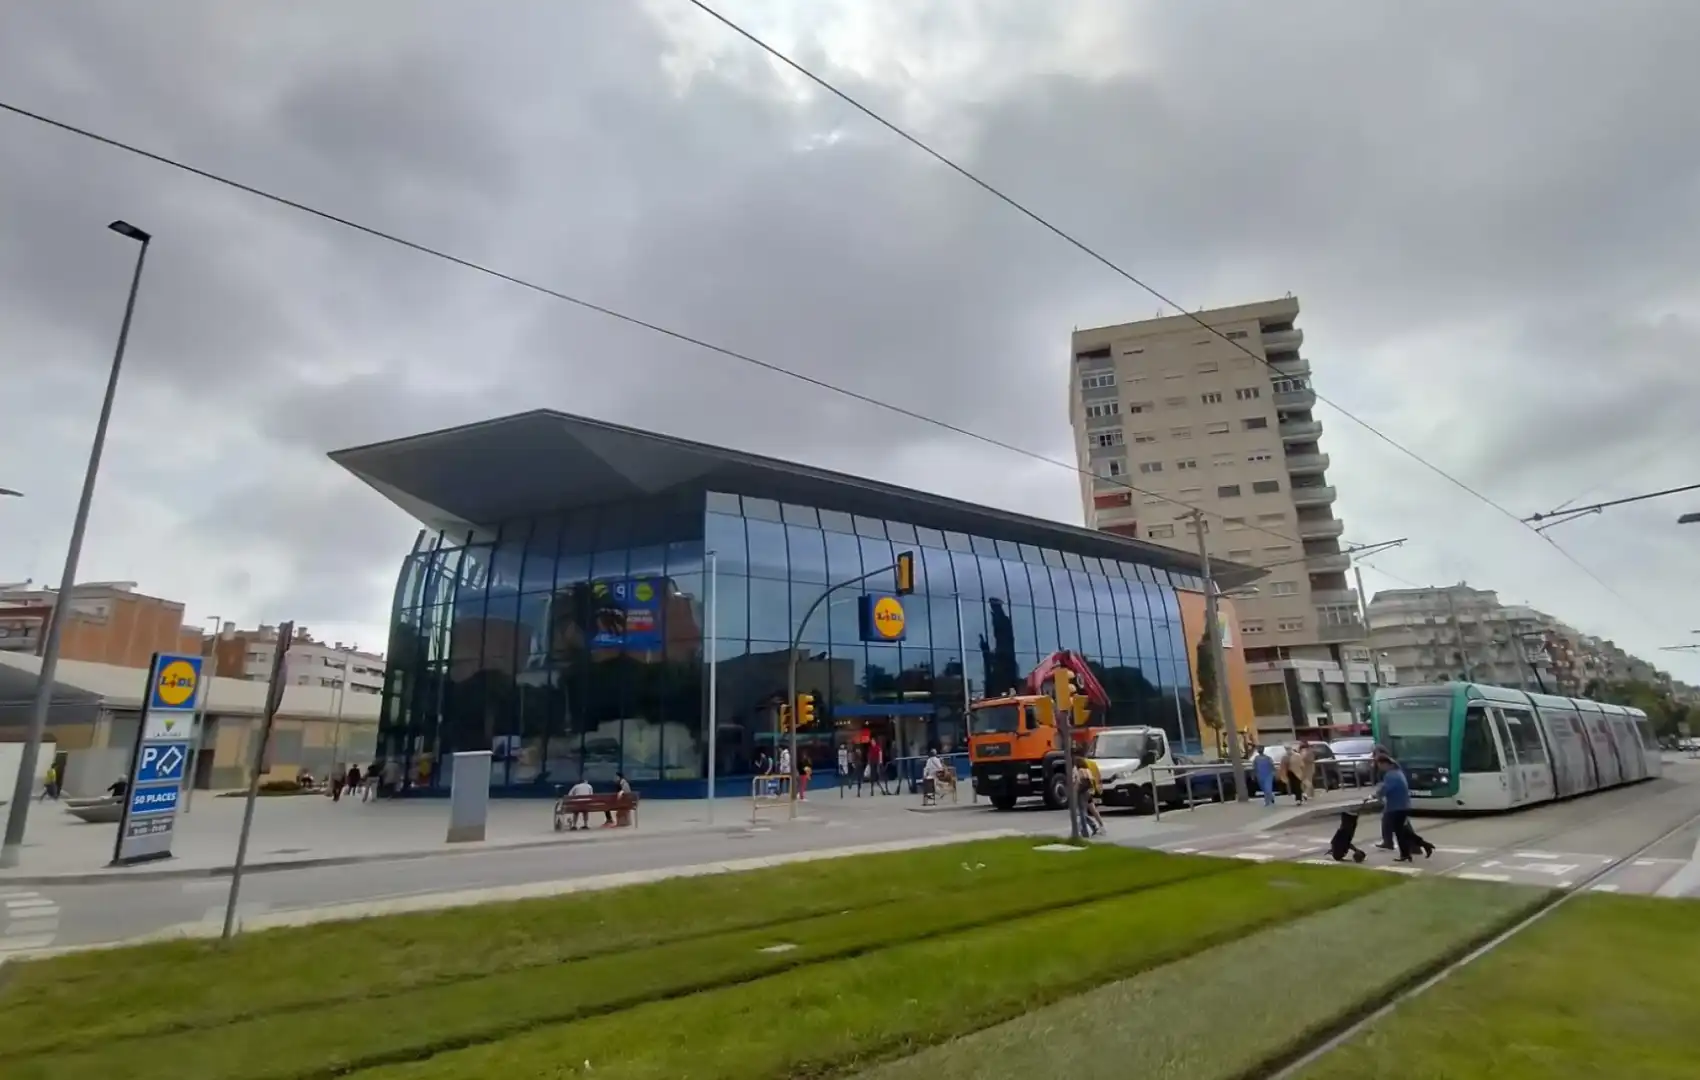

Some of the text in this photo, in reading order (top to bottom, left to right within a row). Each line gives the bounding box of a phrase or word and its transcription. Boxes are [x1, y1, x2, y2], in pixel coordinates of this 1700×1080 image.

[160, 673, 195, 688] LIDL
[142, 747, 158, 769] P
[134, 792, 177, 805] 50 PLACES
